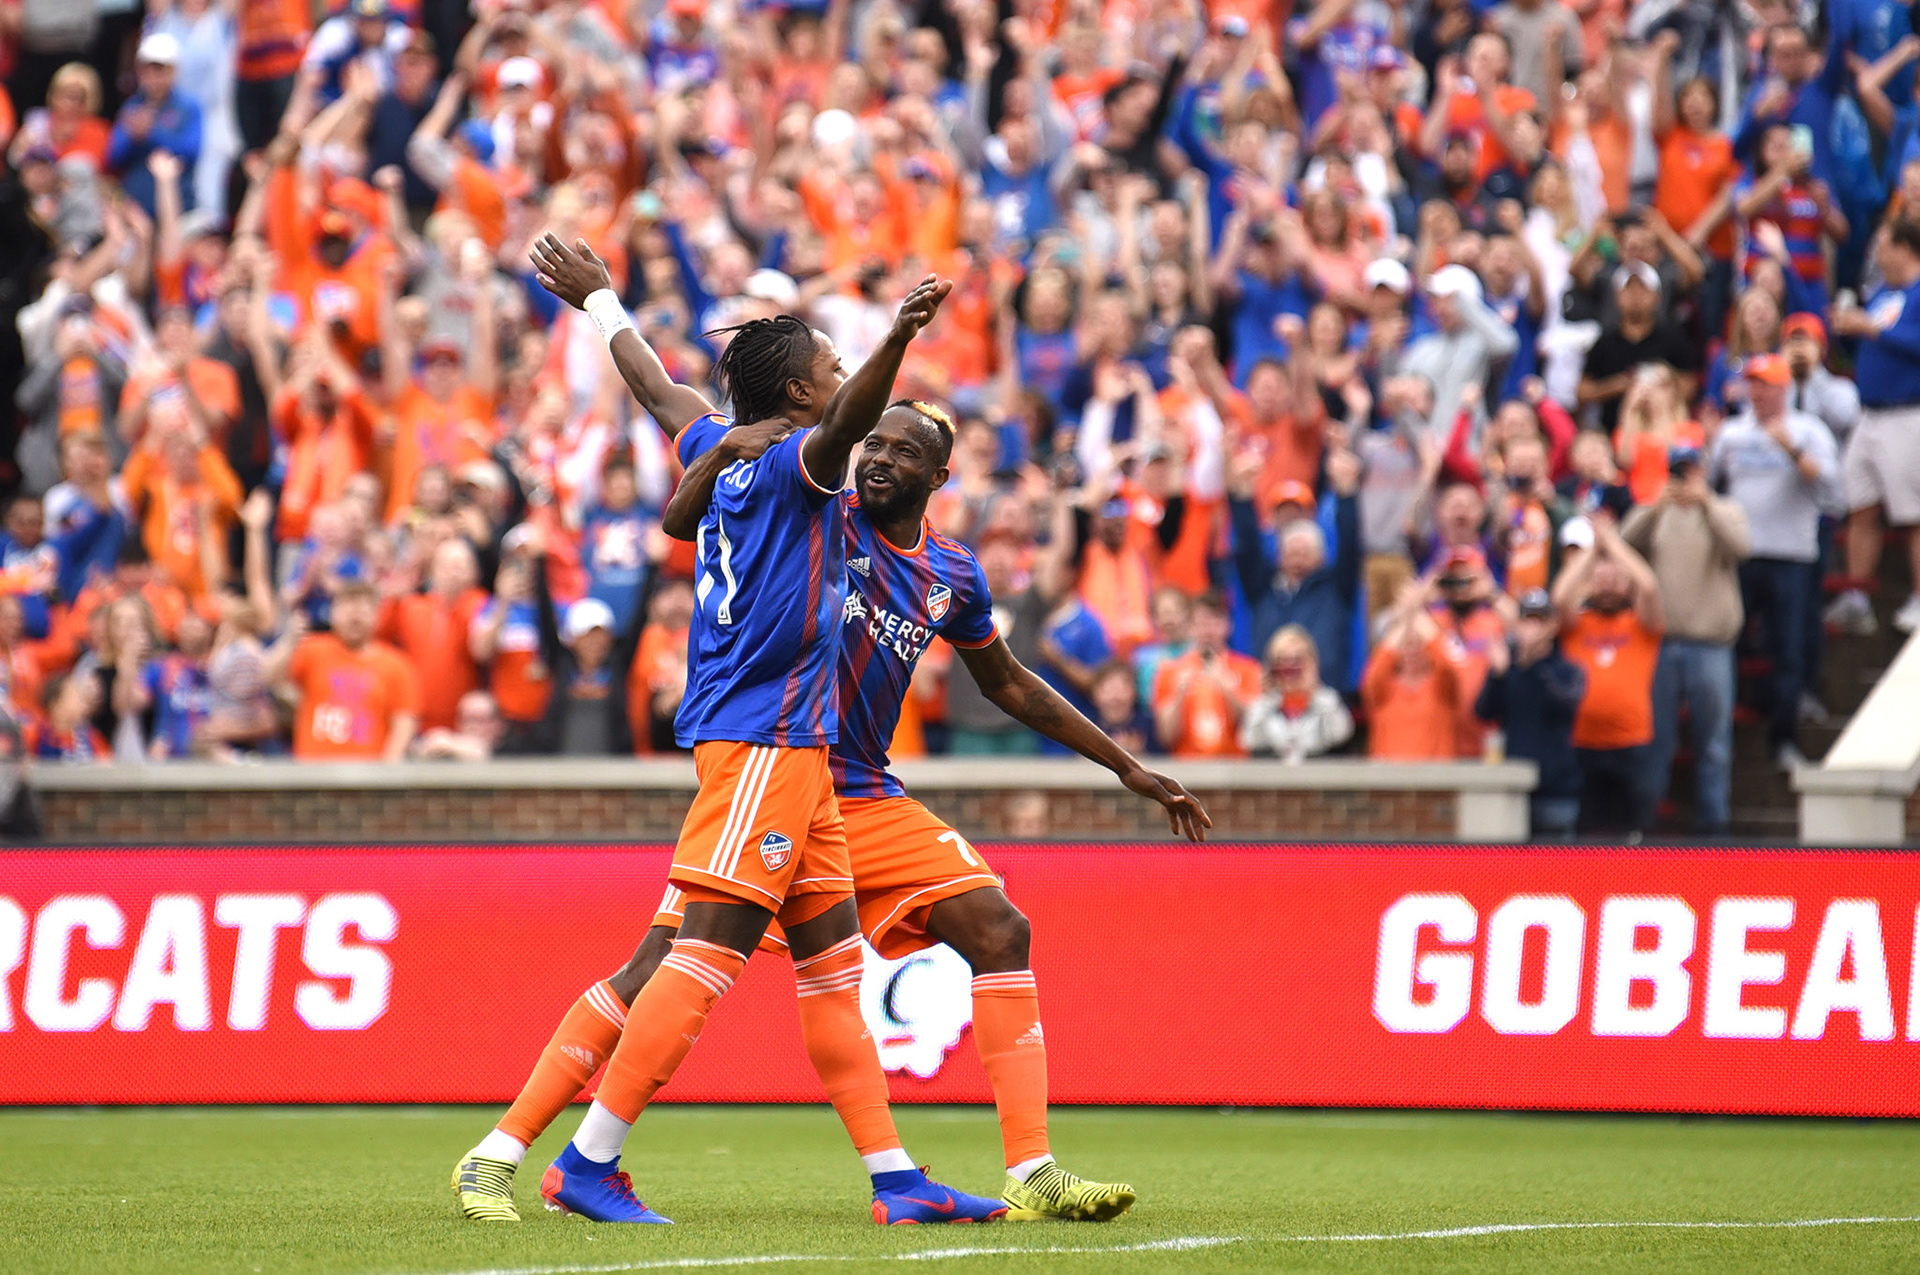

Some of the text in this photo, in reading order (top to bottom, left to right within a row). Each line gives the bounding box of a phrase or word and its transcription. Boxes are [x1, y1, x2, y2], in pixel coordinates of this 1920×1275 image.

[846, 559, 871, 578] adidas
[873, 604, 934, 645] MERCY
[936, 830, 979, 867] 7
[1371, 891, 1920, 1042] GOBEA
